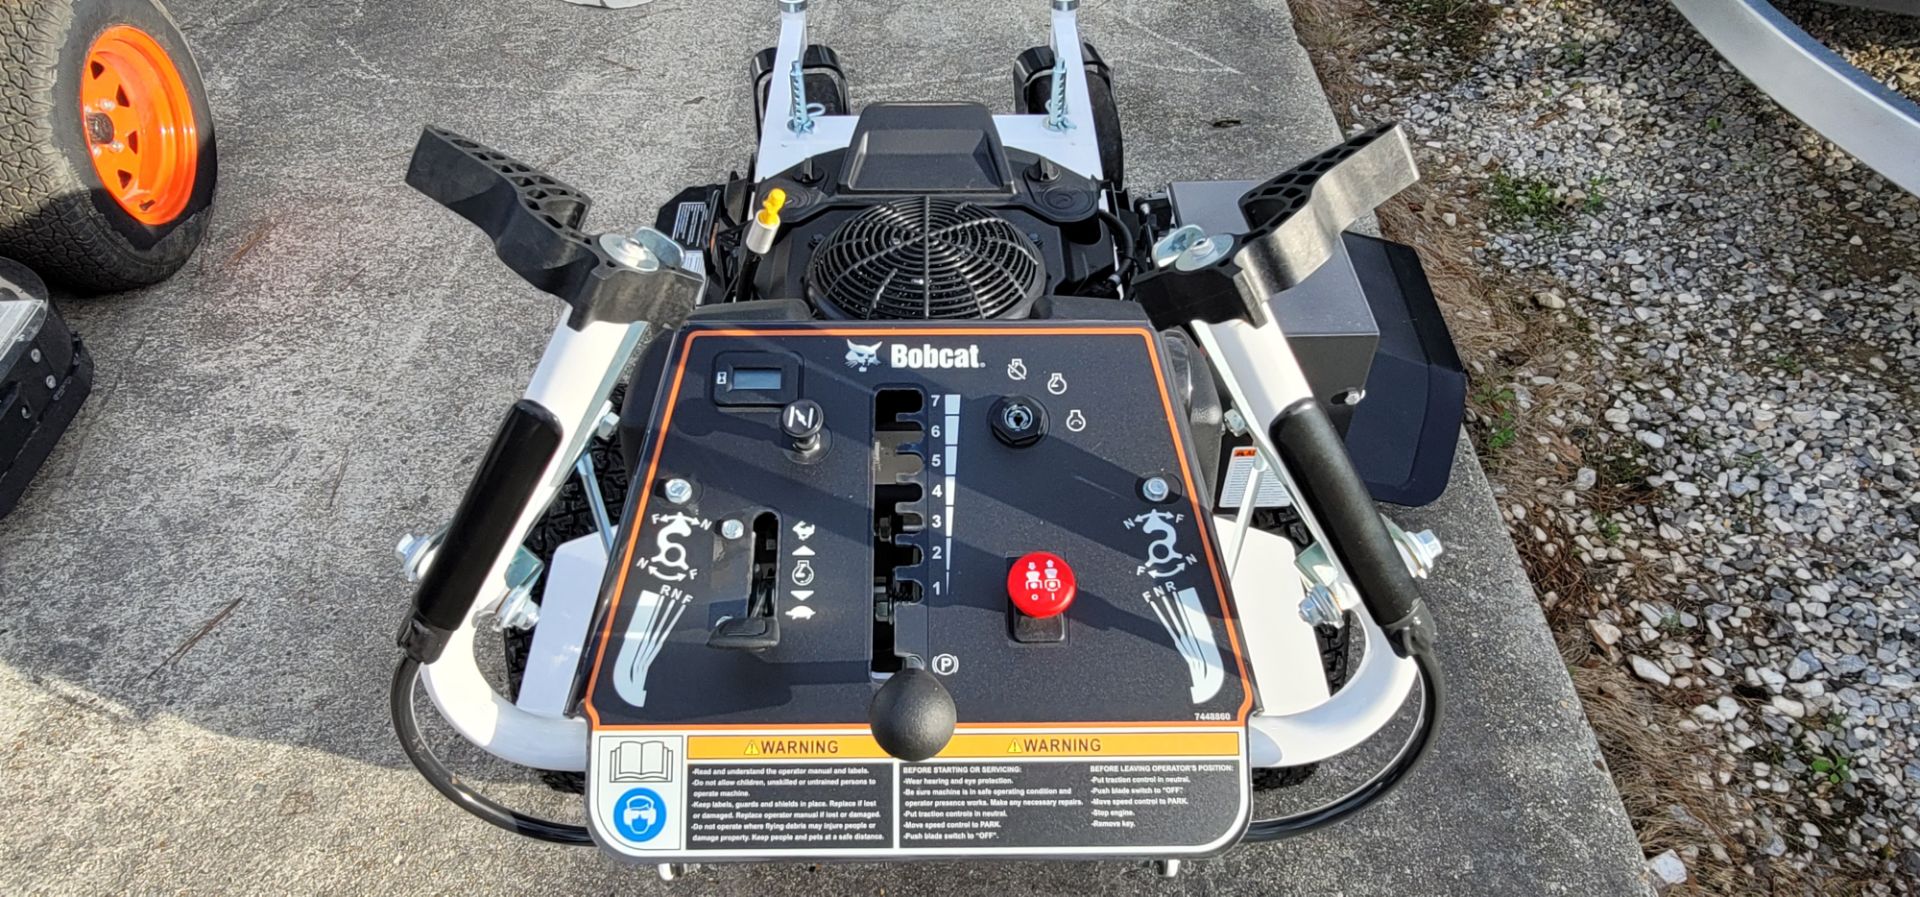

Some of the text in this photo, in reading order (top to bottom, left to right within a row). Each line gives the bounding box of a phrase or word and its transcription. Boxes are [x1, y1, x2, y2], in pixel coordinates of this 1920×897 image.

[891, 344, 980, 369] Bobcat
[931, 395, 940, 407] 7
[931, 425, 940, 438] 6
[932, 454, 941, 467] 5
[932, 485, 942, 498] 4
[651, 514, 660, 524] F
[700, 519, 712, 531] N
[932, 515, 941, 528] 3
[1123, 518, 1136, 530] N
[1176, 513, 1185, 524] F
[932, 546, 942, 559] 2
[636, 557, 648, 569] N
[1185, 553, 1198, 566] N
[689, 568, 698, 580] F
[1137, 565, 1146, 576] F
[660, 584, 693, 604] R N F
[932, 582, 940, 595] 1
[1142, 580, 1176, 602] F N R
[761, 740, 839, 754] WARNING
[1023, 738, 1101, 753] WARNING
